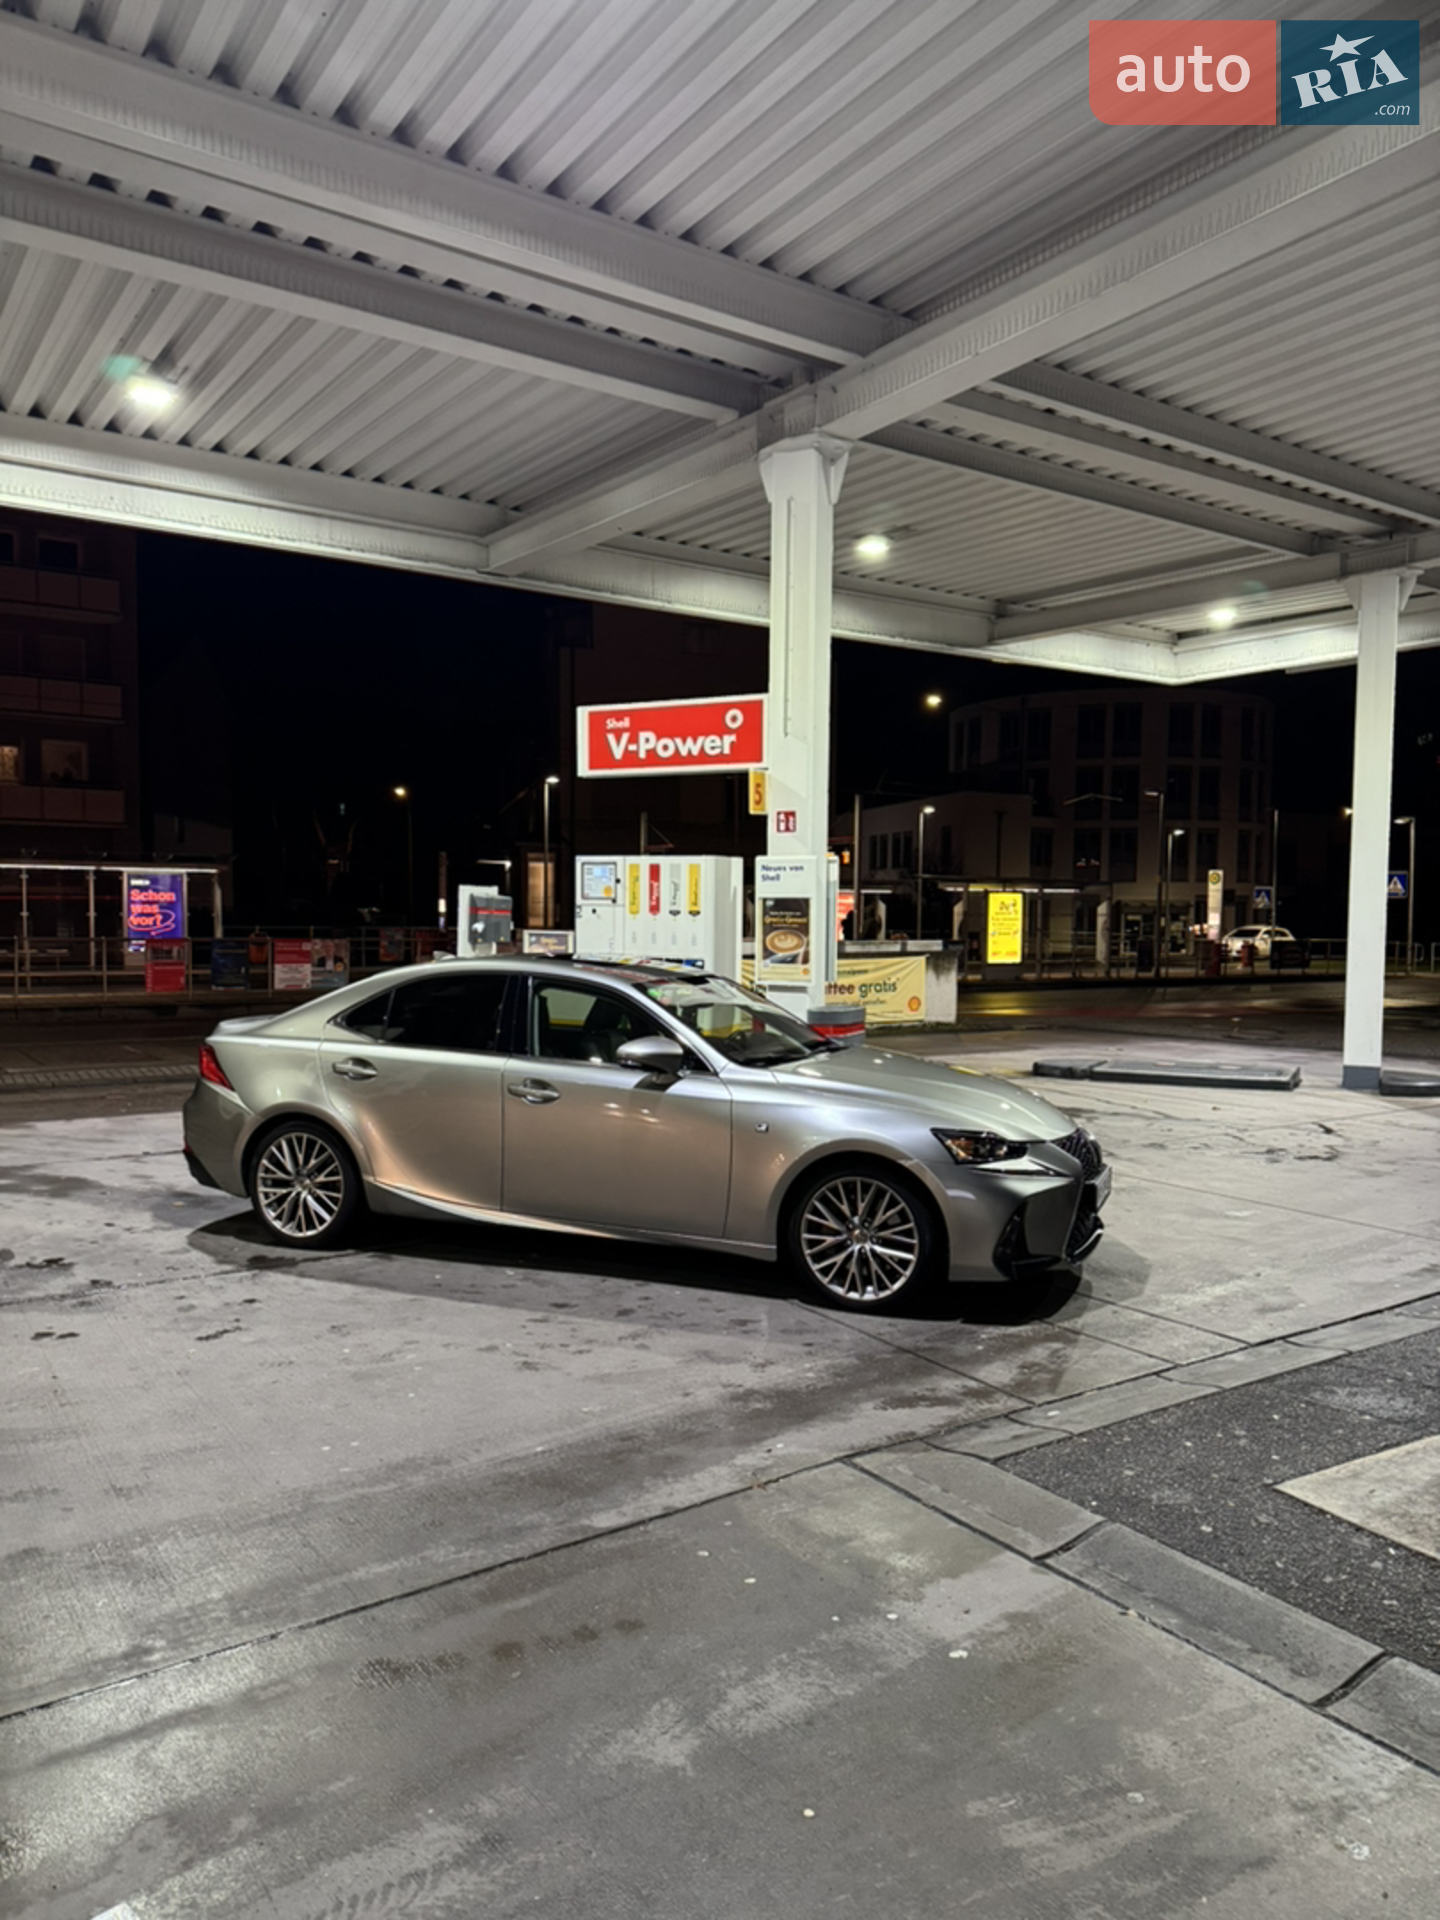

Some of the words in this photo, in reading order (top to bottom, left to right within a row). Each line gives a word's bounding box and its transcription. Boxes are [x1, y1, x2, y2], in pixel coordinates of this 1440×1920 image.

[606, 716, 630, 730] Shell
[606, 730, 737, 761] V-Power
[753, 783, 763, 806] 5
[761, 864, 787, 872] Neues
[761, 873, 781, 882] Shell
[130, 888, 176, 902] Schon
[824, 981, 856, 996] ffee
